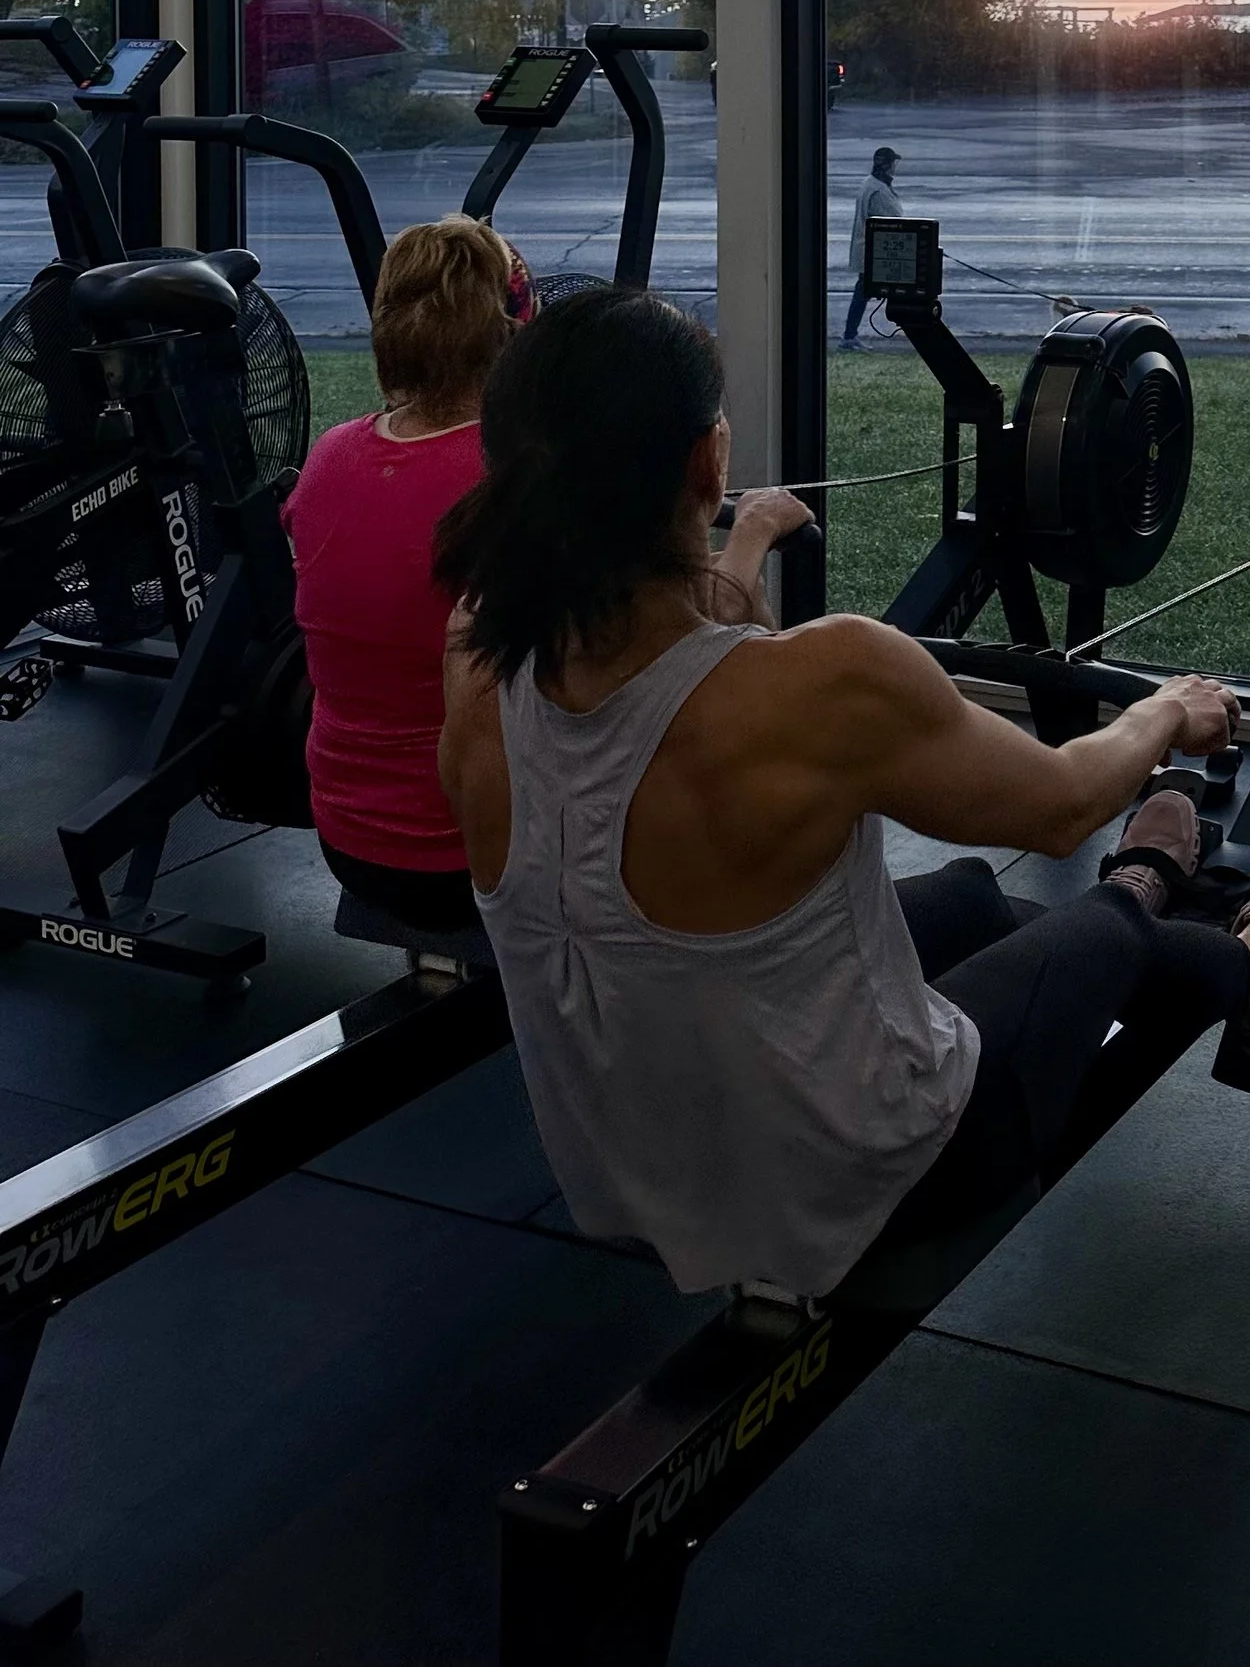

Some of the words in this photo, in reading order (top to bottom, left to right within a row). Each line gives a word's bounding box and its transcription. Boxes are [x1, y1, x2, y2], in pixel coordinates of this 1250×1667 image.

[127, 41, 161, 49] ROGUE
[528, 48, 570, 57] ROGUE
[71, 485, 107, 522] ECHO
[109, 465, 140, 498] BIKE
[162, 490, 204, 622] ROGUE
[41, 919, 133, 958] ROGUE
